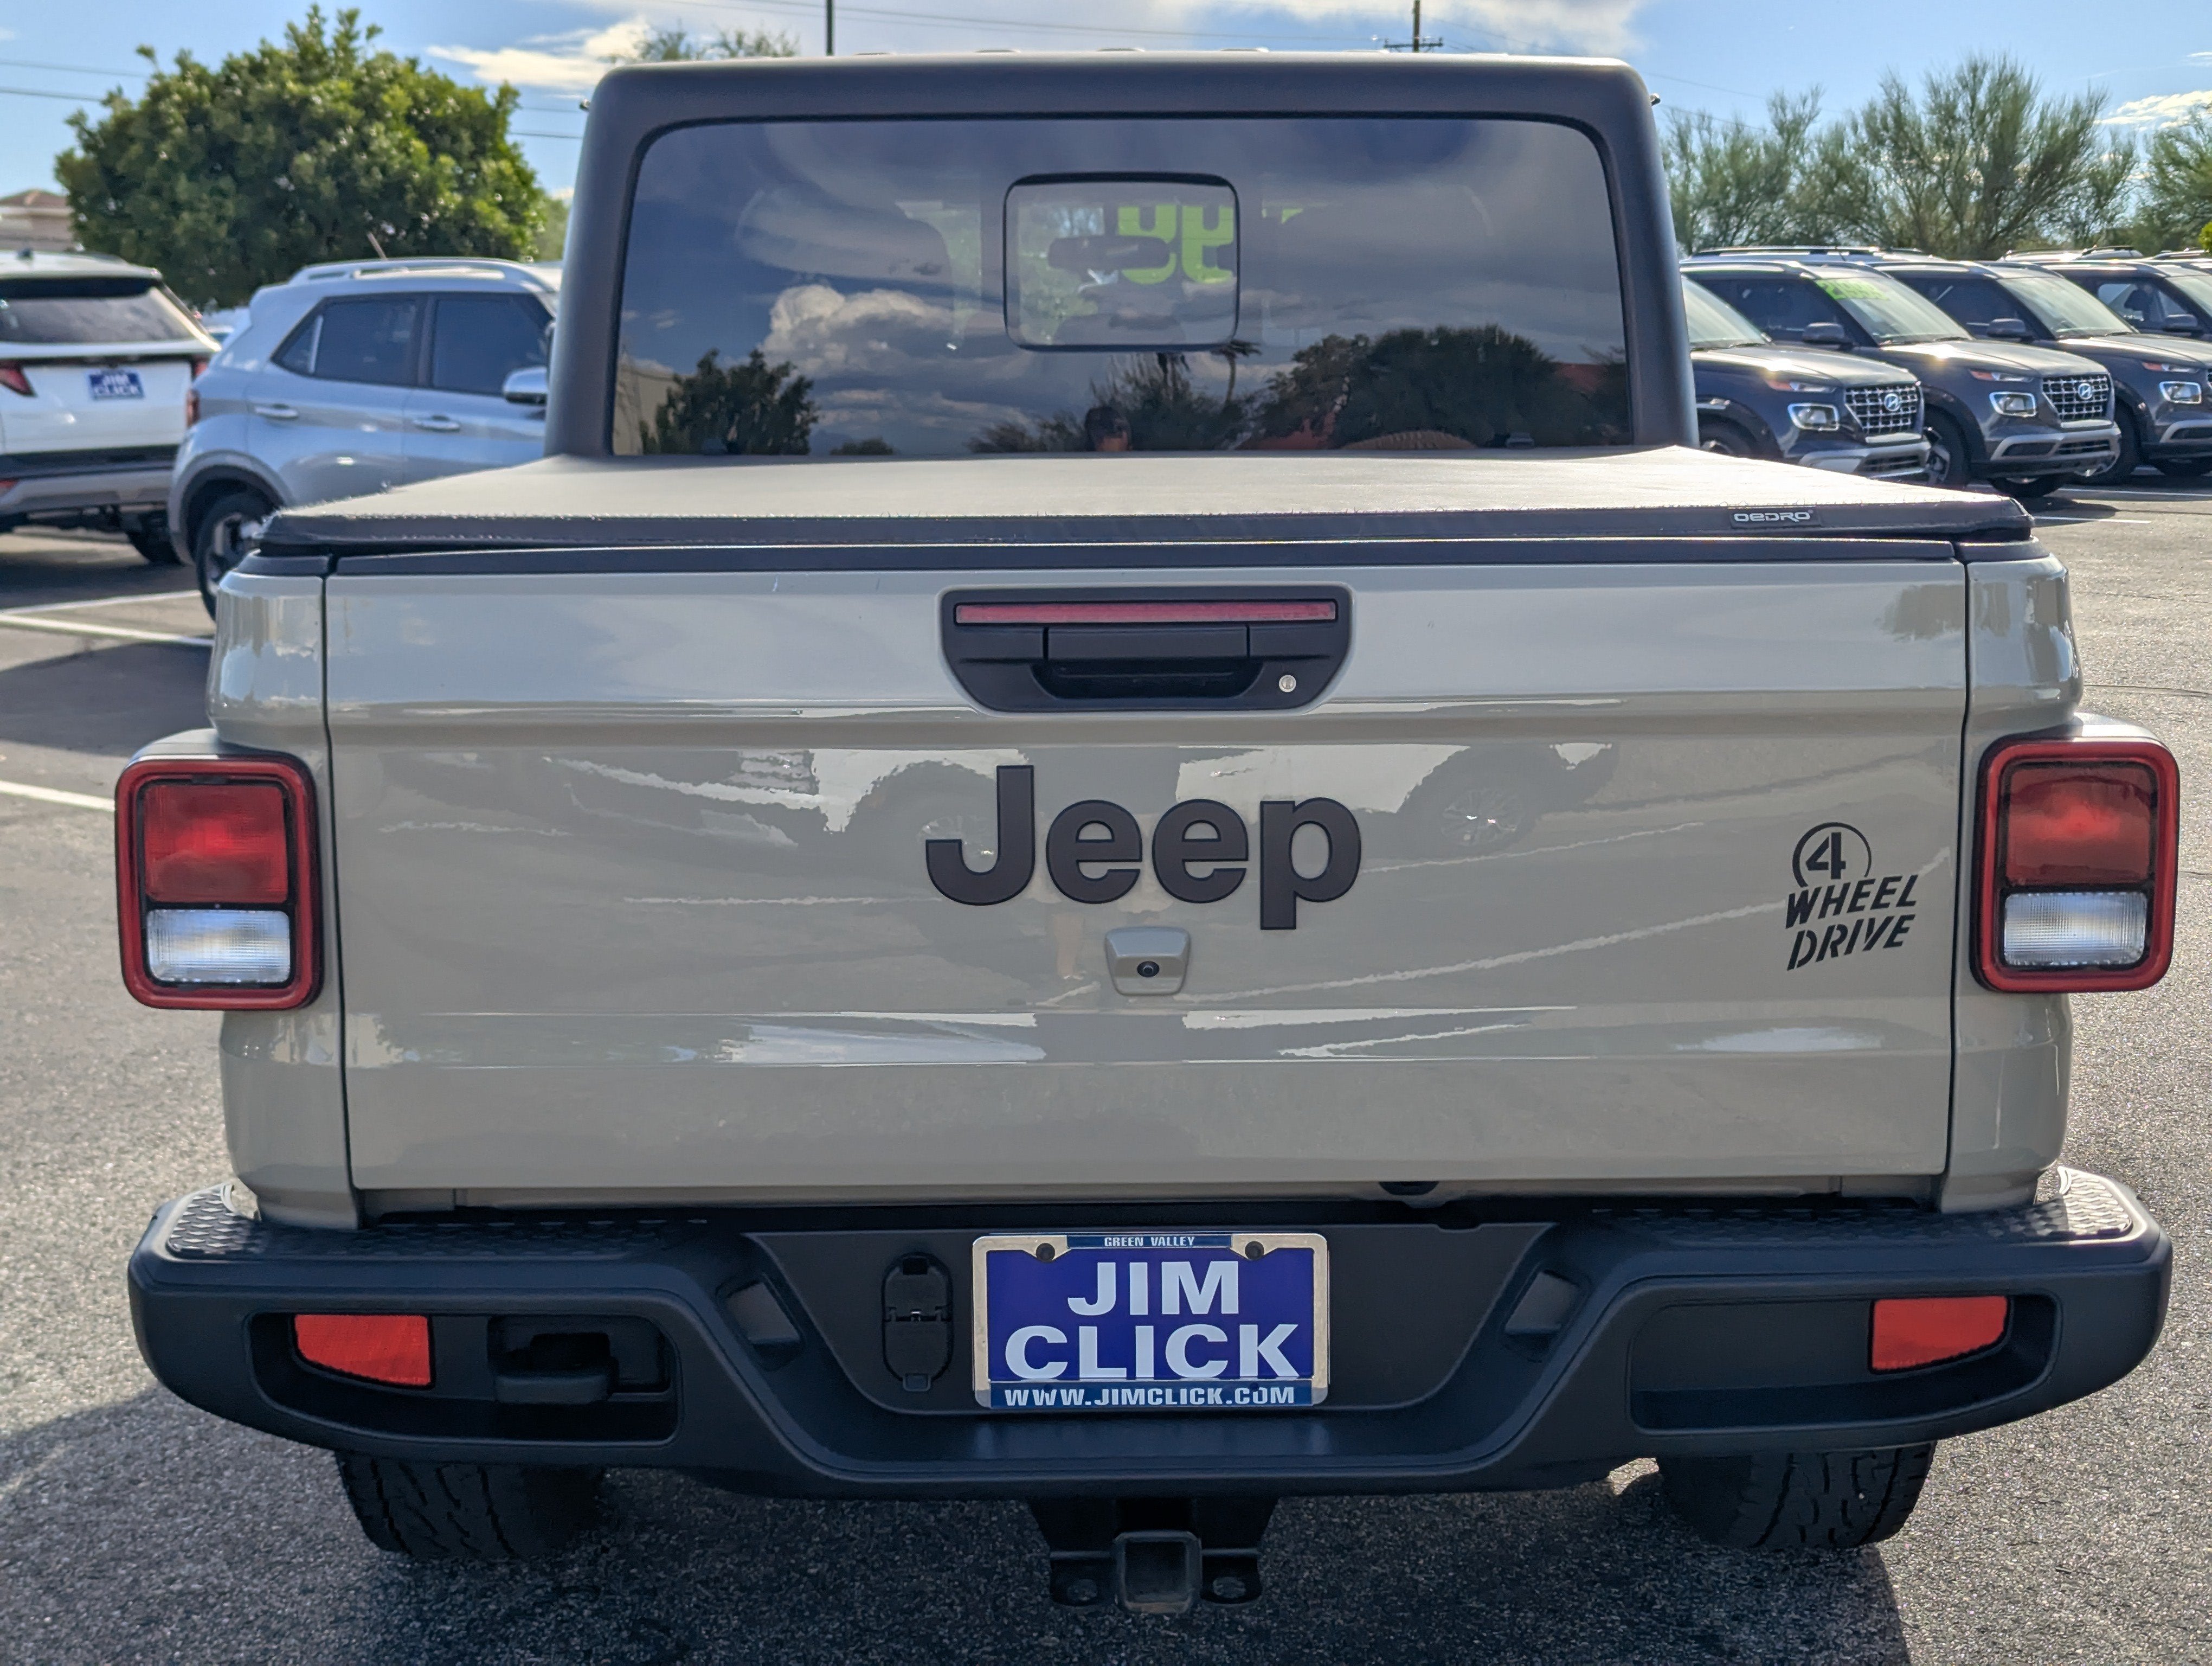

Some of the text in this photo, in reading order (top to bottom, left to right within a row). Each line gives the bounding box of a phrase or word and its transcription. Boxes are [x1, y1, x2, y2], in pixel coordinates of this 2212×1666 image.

[925, 765, 1362, 930] Jeep
[1805, 831, 1847, 880] 4
[1785, 874, 1919, 930] WHEEL
[1786, 914, 1916, 971] DRIVE
[1104, 1236, 1195, 1247] GREEN VALLEY
[1067, 1260, 1239, 1316] JIM
[1005, 1323, 1300, 1379] CLICK
[1004, 1386, 1295, 1406] WWW.JIMCLICK.COM
